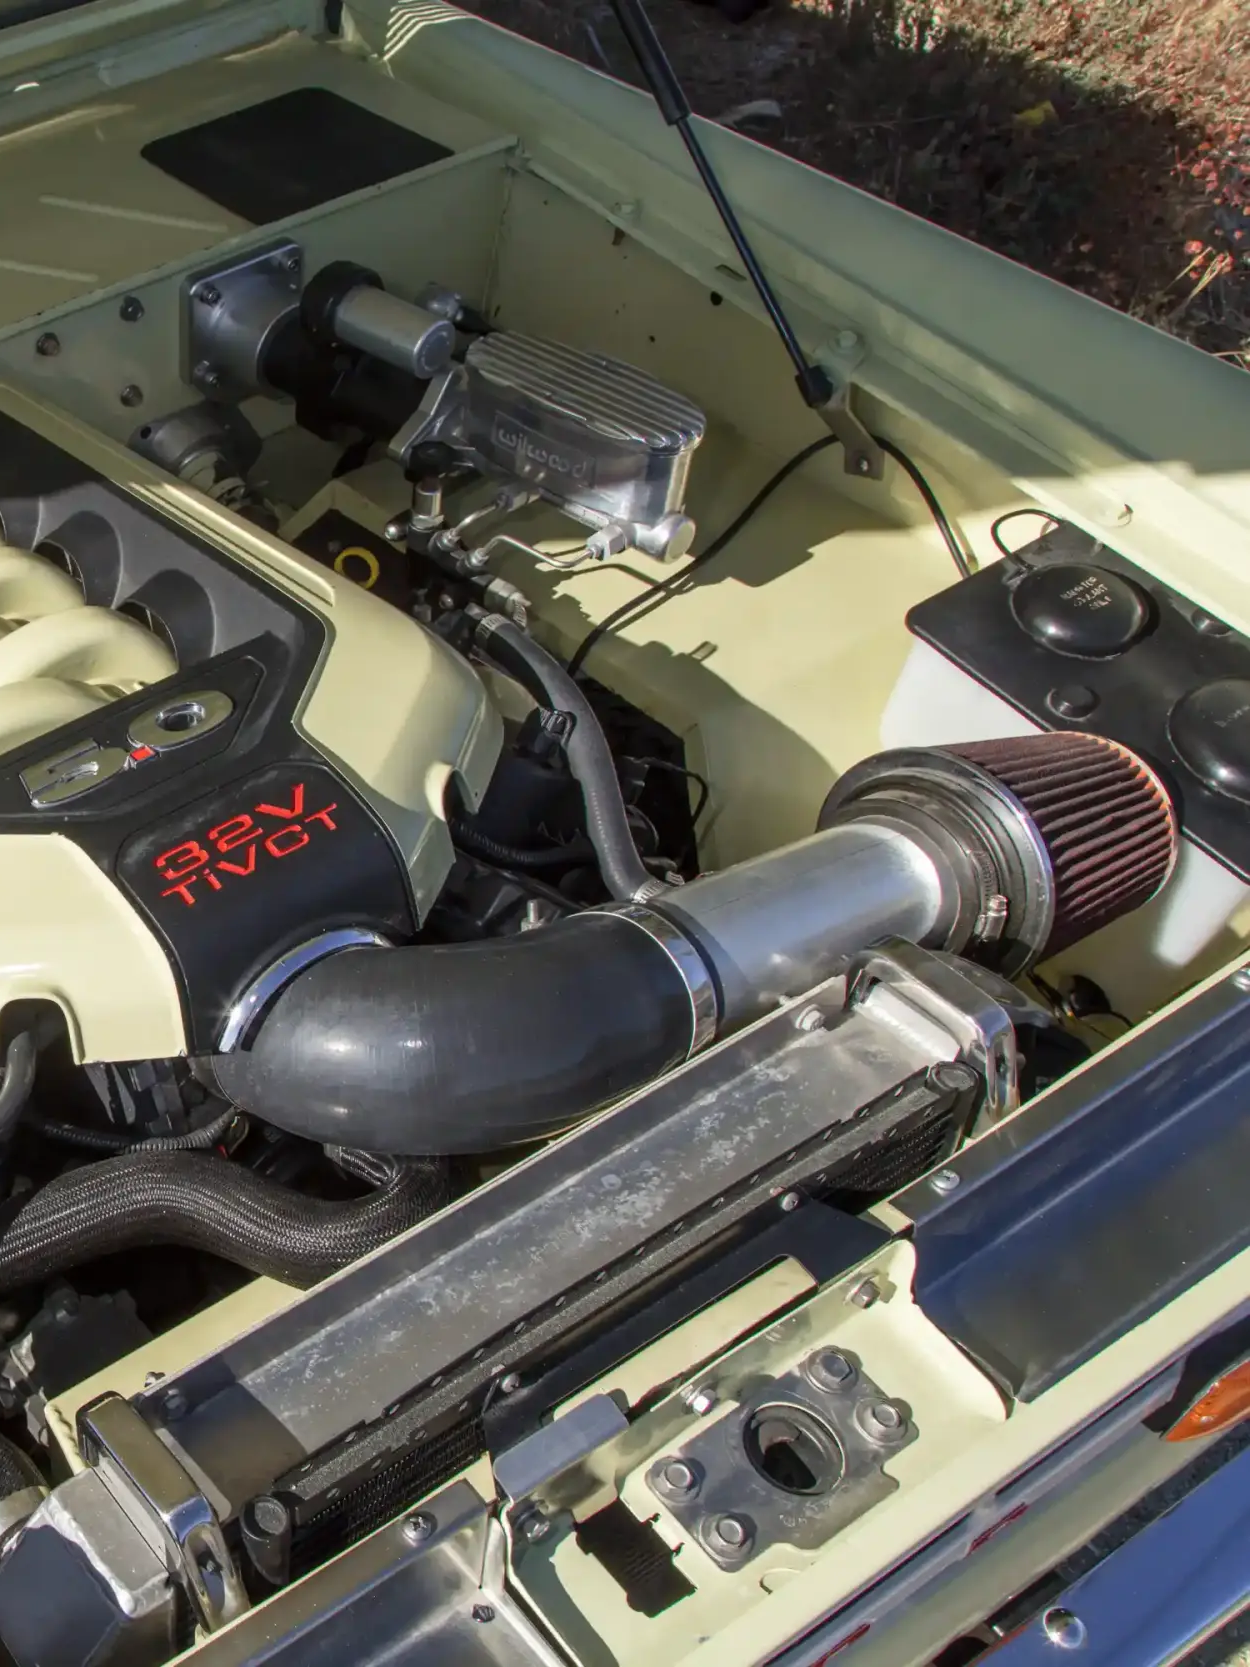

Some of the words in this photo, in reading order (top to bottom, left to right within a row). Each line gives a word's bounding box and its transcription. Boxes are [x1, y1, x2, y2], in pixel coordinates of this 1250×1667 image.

[498, 429, 587, 479] wilwood
[18, 690, 234, 809] 5.0
[155, 783, 305, 881] 32V
